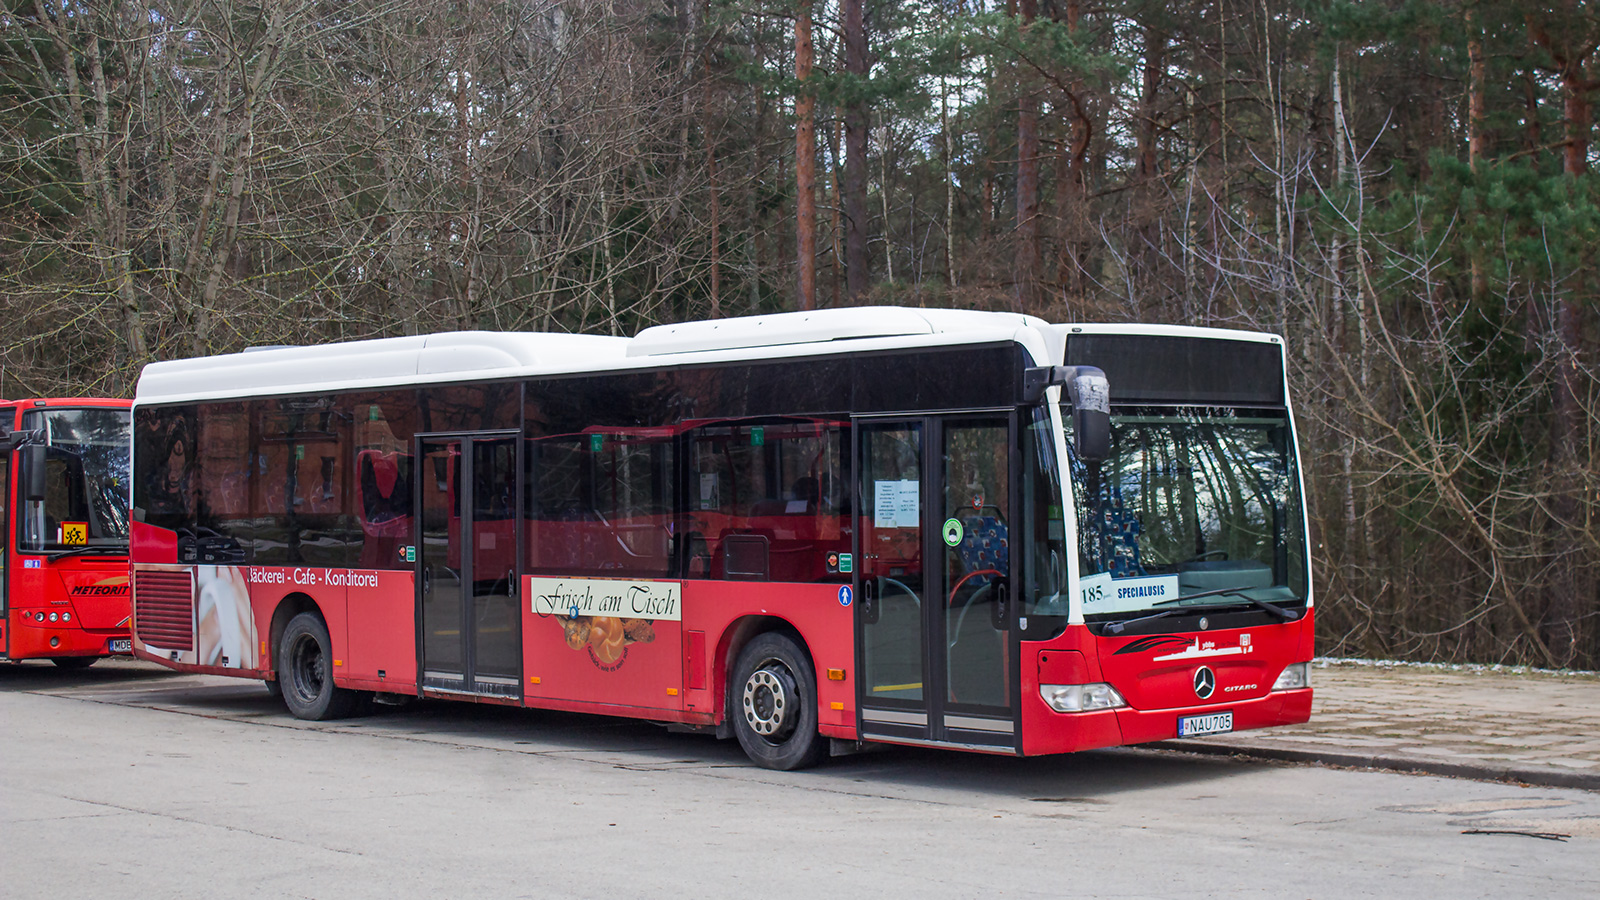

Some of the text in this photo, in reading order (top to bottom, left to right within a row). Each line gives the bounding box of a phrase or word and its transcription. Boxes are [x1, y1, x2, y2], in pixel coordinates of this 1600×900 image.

[293, 568, 316, 585] Cafe
[325, 569, 378, 587] Konditorei
[71, 586, 130, 595] METEORIT
[1081, 584, 1103, 604] 185
[1117, 584, 1165, 599] SPECIALUSIS
[535, 583, 675, 618] Frisch am Tisch
[1190, 715, 1231, 732] NAU705
